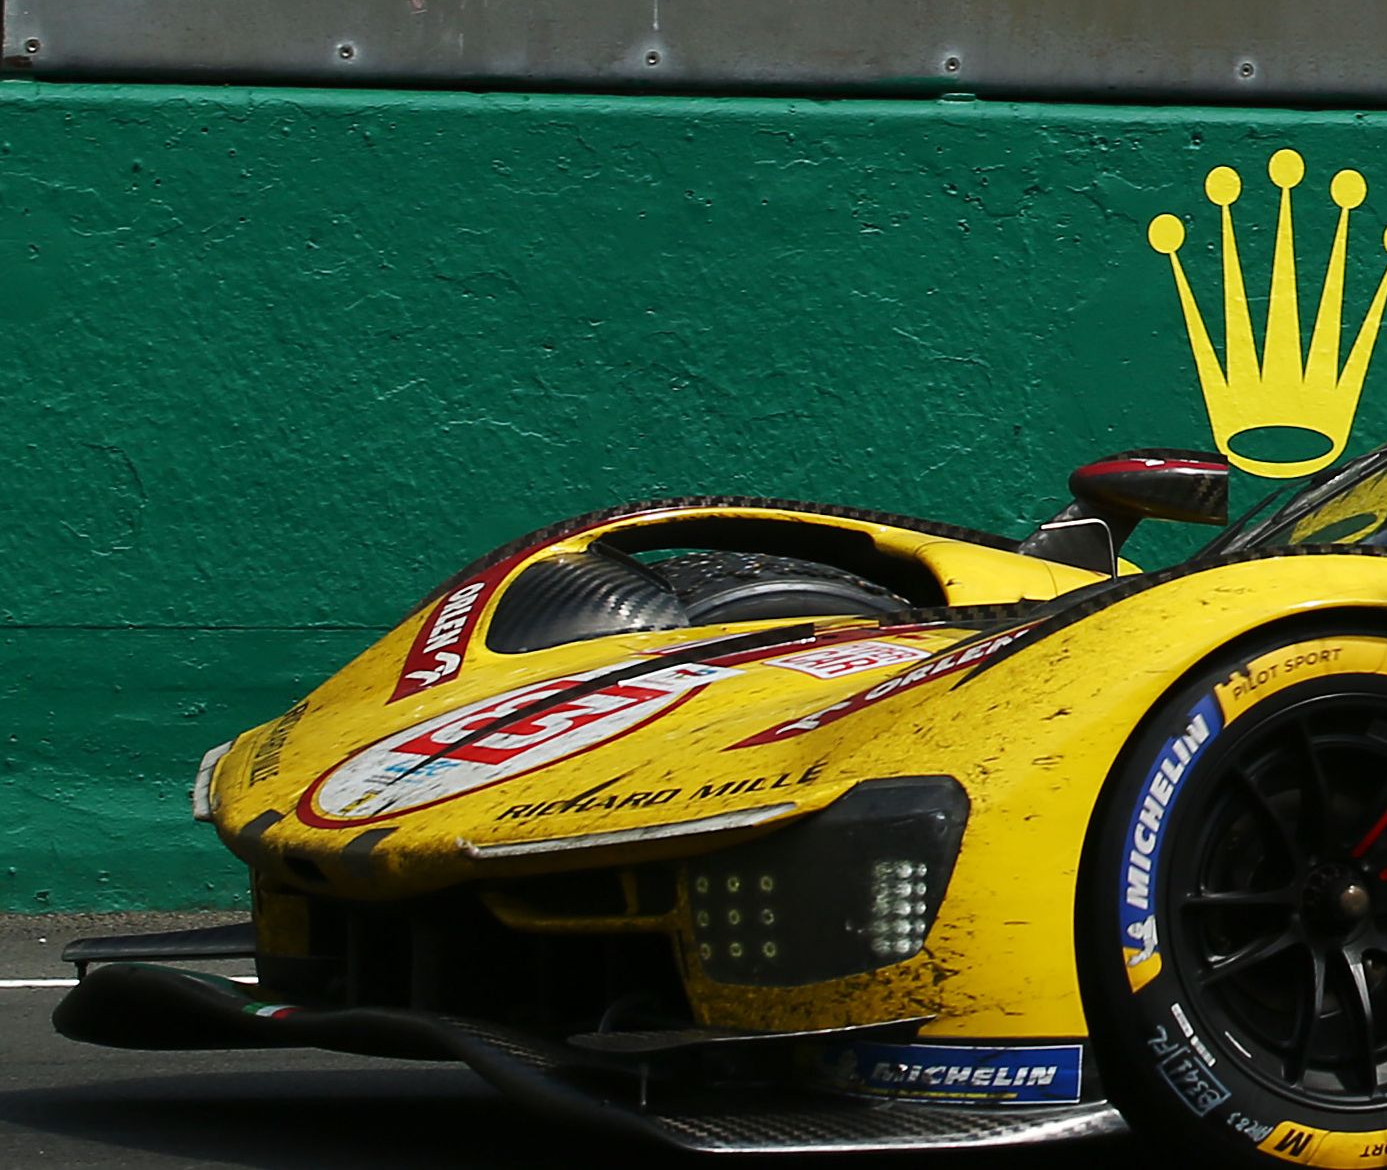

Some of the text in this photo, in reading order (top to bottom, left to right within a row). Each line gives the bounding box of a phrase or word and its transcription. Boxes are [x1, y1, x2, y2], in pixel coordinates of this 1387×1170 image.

[422, 582, 486, 654] ORLEN
[864, 629, 1030, 701] ORLEN
[1231, 647, 1343, 701] PILOT SPORT
[496, 759, 829, 822] RICHARD MILLE
[1126, 712, 1211, 910] MICHELIN
[871, 1062, 1058, 1087] MICHELIN
[1272, 1128, 1314, 1158] M
